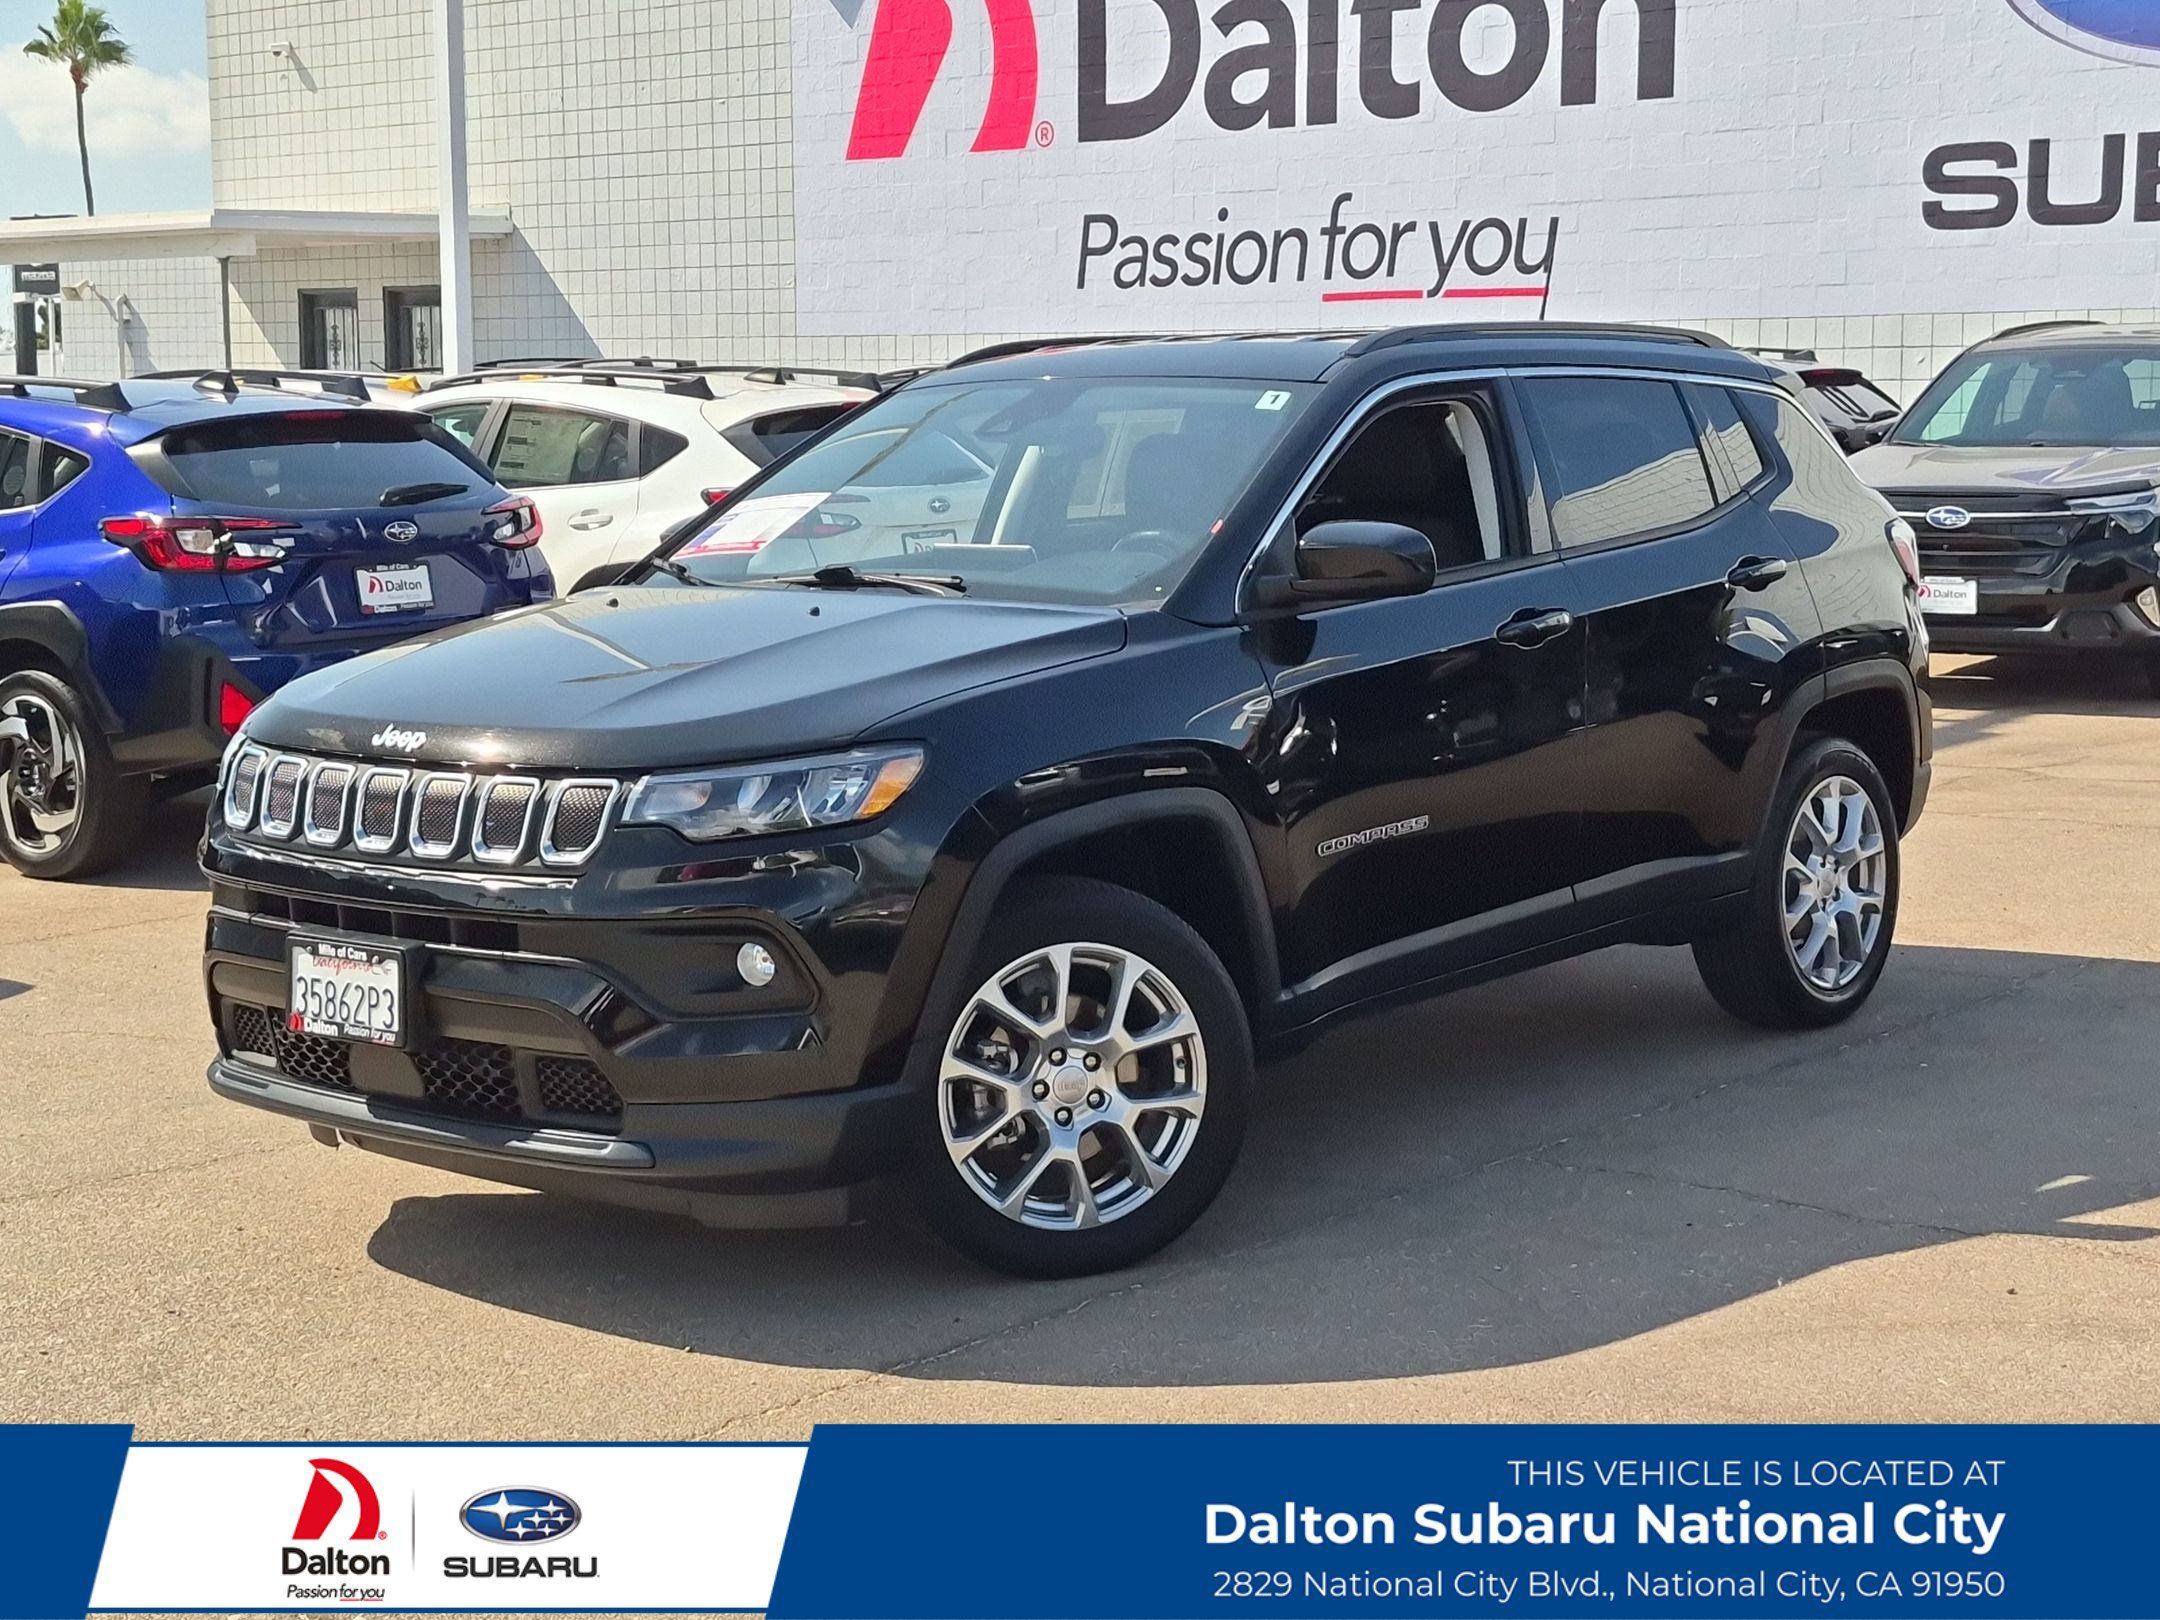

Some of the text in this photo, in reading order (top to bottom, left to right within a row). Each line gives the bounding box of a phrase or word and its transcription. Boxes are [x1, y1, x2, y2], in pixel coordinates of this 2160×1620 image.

[1078, 0, 1675, 142] Dalton
[1922, 133, 2160, 230] SU
[1076, 192, 1559, 298] Passion for you
[385, 579, 422, 592] Dalton
[1933, 589, 1967, 599] Dalton
[371, 722, 427, 752] Jeep
[1318, 815, 1429, 857] COMPASS
[318, 943, 368, 961] Mile of Cars
[296, 975, 395, 1029] 35862P3
[303, 1017, 396, 1043] Dalton Passion for you
